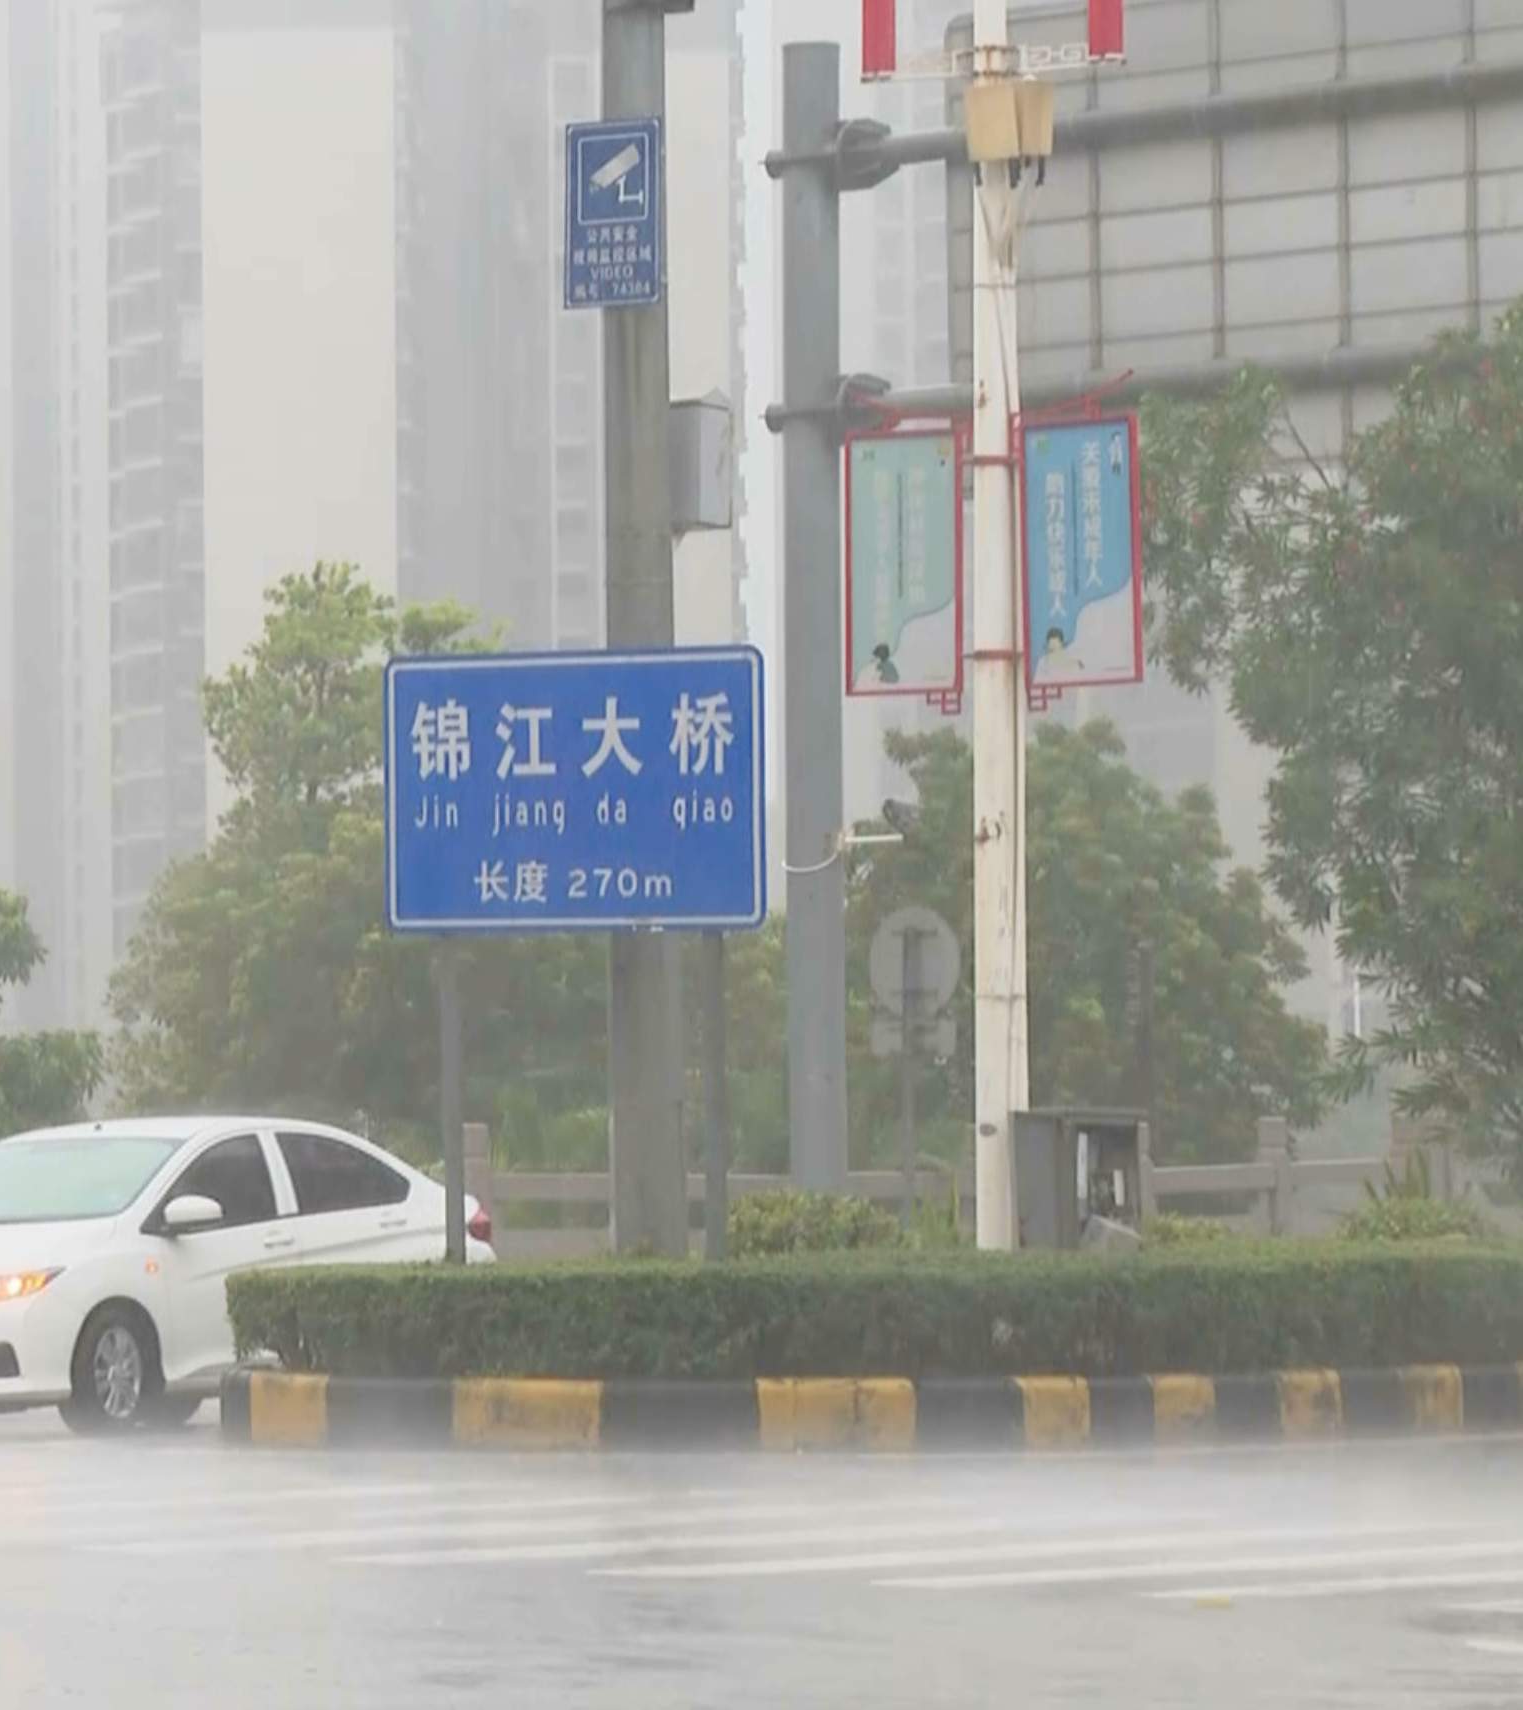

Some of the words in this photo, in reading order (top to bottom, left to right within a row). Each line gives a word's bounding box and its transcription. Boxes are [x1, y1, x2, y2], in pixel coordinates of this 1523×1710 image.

[590, 264, 634, 281] VIDEO
[411, 692, 734, 782] 锦江大桥
[415, 795, 459, 829] Jin
[492, 793, 566, 837] jiang
[595, 789, 628, 825] da
[672, 788, 734, 831] qiao
[474, 860, 548, 903] 长度
[567, 868, 673, 898] 270m
